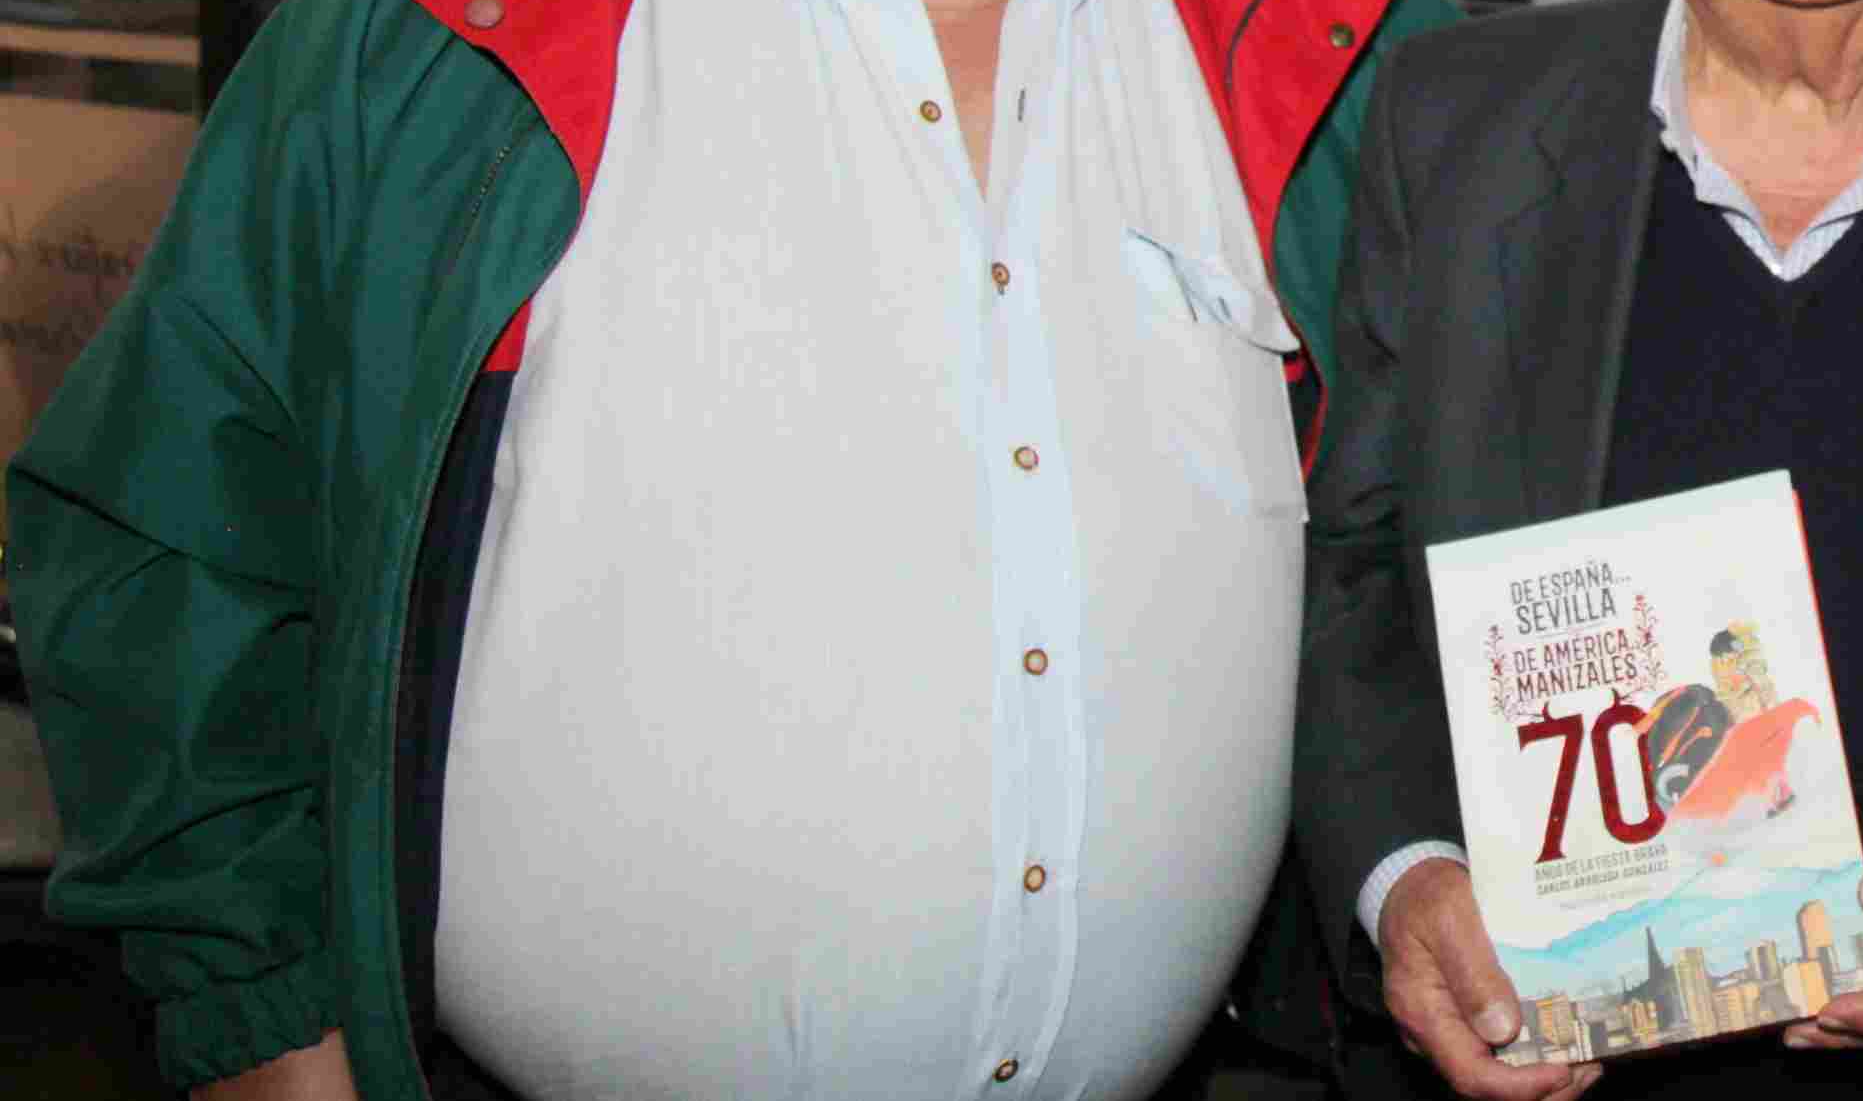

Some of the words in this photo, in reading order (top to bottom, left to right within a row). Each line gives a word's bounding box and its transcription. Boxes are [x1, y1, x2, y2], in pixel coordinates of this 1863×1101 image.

[1510, 579, 1536, 605] DE
[1516, 587, 1617, 635] SEVILLA
[1513, 648, 1538, 674] DE
[1517, 652, 1638, 702] MANIZALES
[1517, 688, 1667, 864] 70
